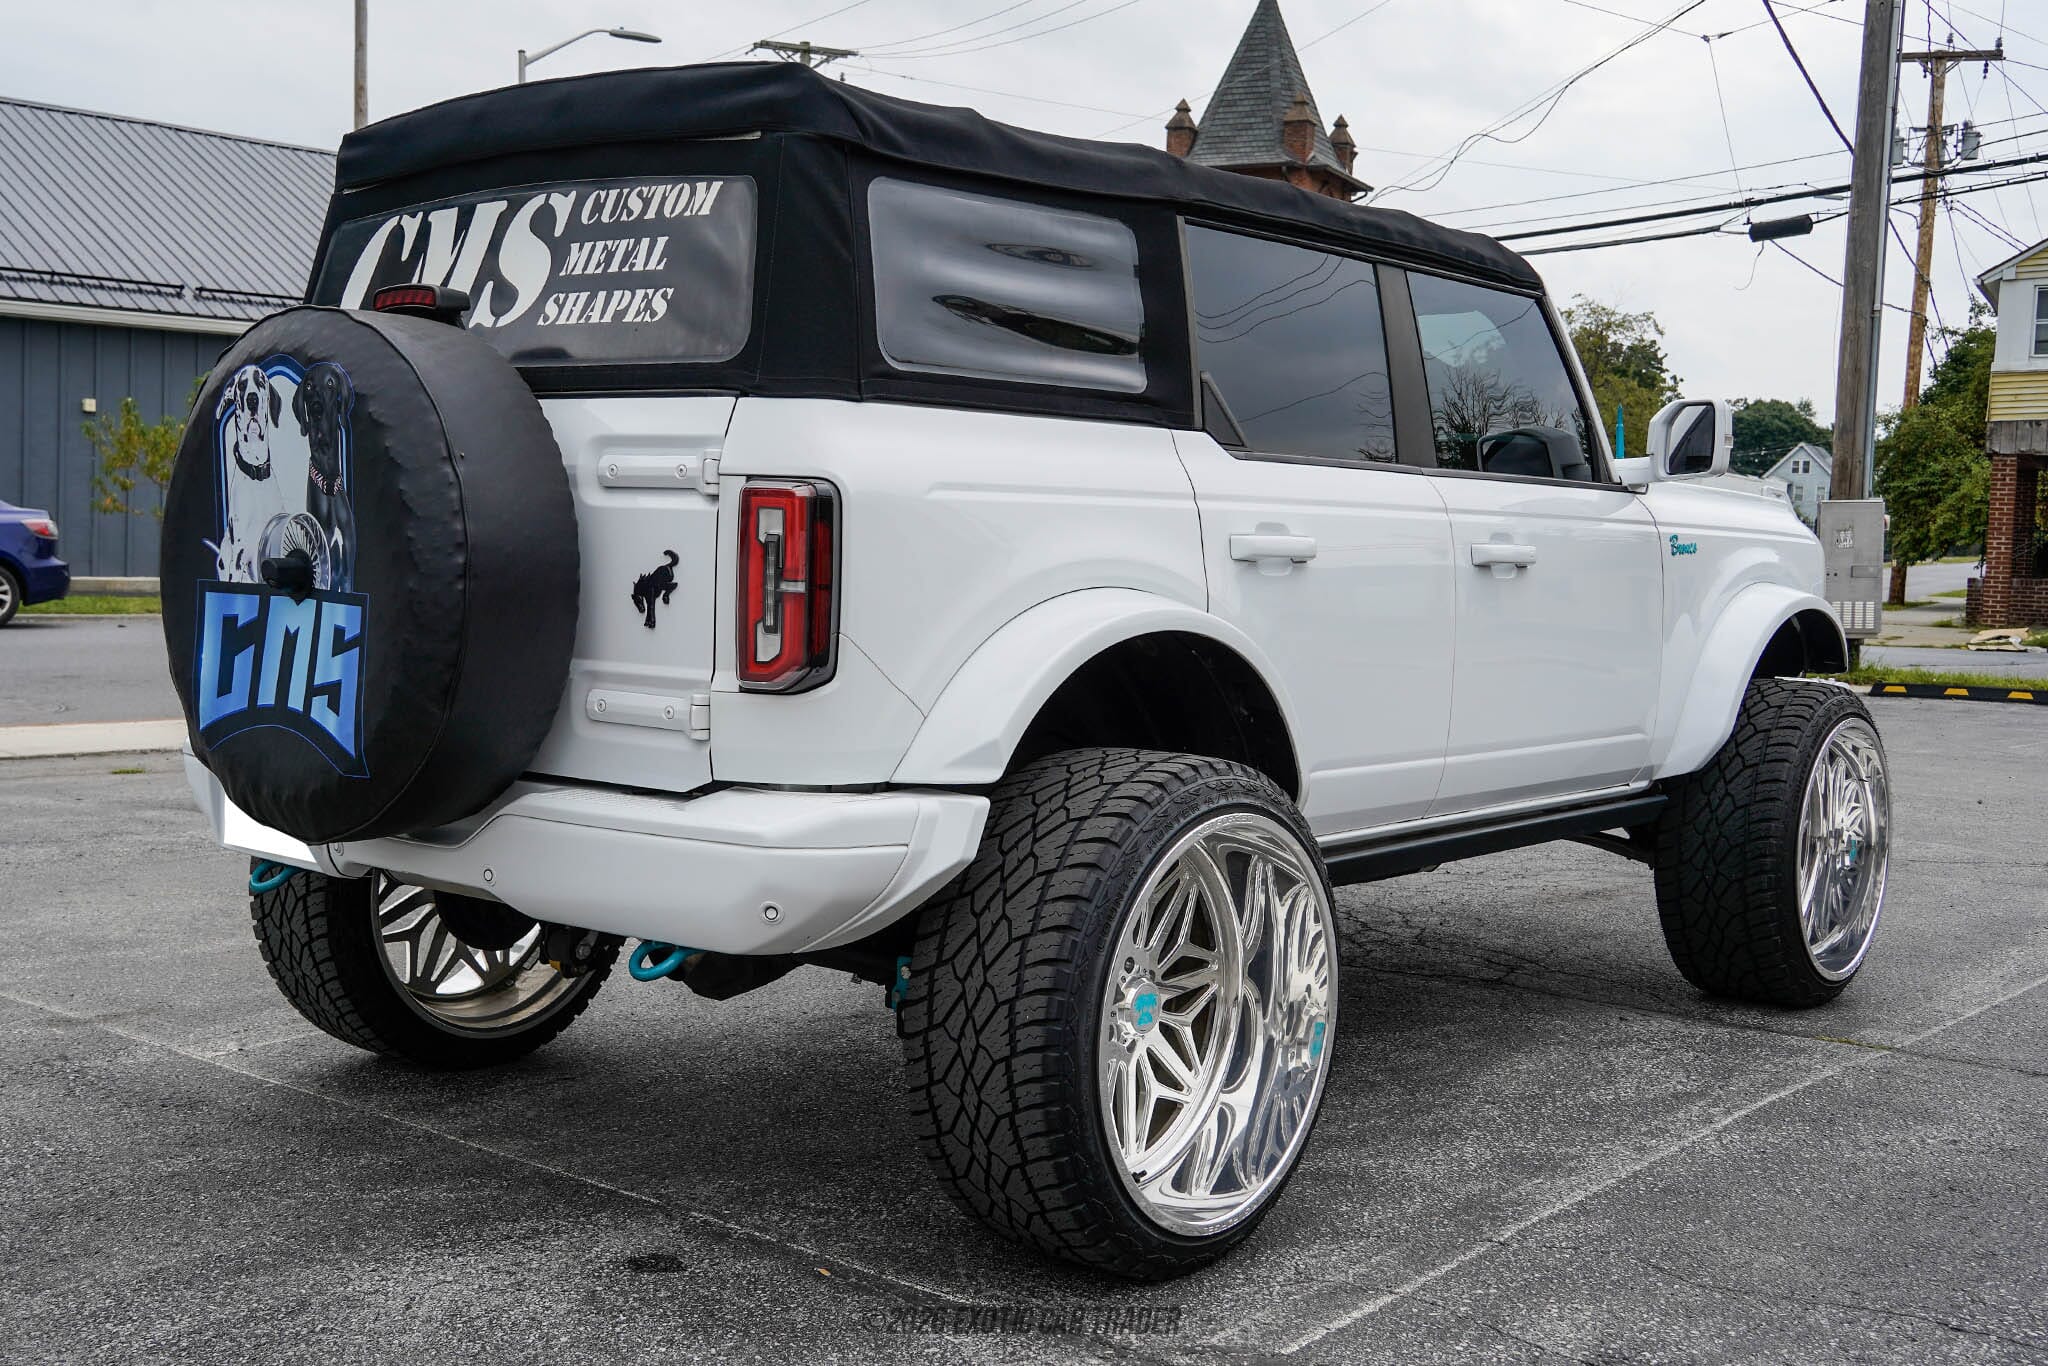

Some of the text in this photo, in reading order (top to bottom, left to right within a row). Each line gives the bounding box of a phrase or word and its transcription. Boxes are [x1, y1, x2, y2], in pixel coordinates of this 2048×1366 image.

[581, 181, 724, 225] CUSTOM
[340, 191, 577, 329] CMS
[559, 236, 669, 276] METAL
[537, 287, 675, 327] SHAPES
[199, 591, 363, 759] CMS
